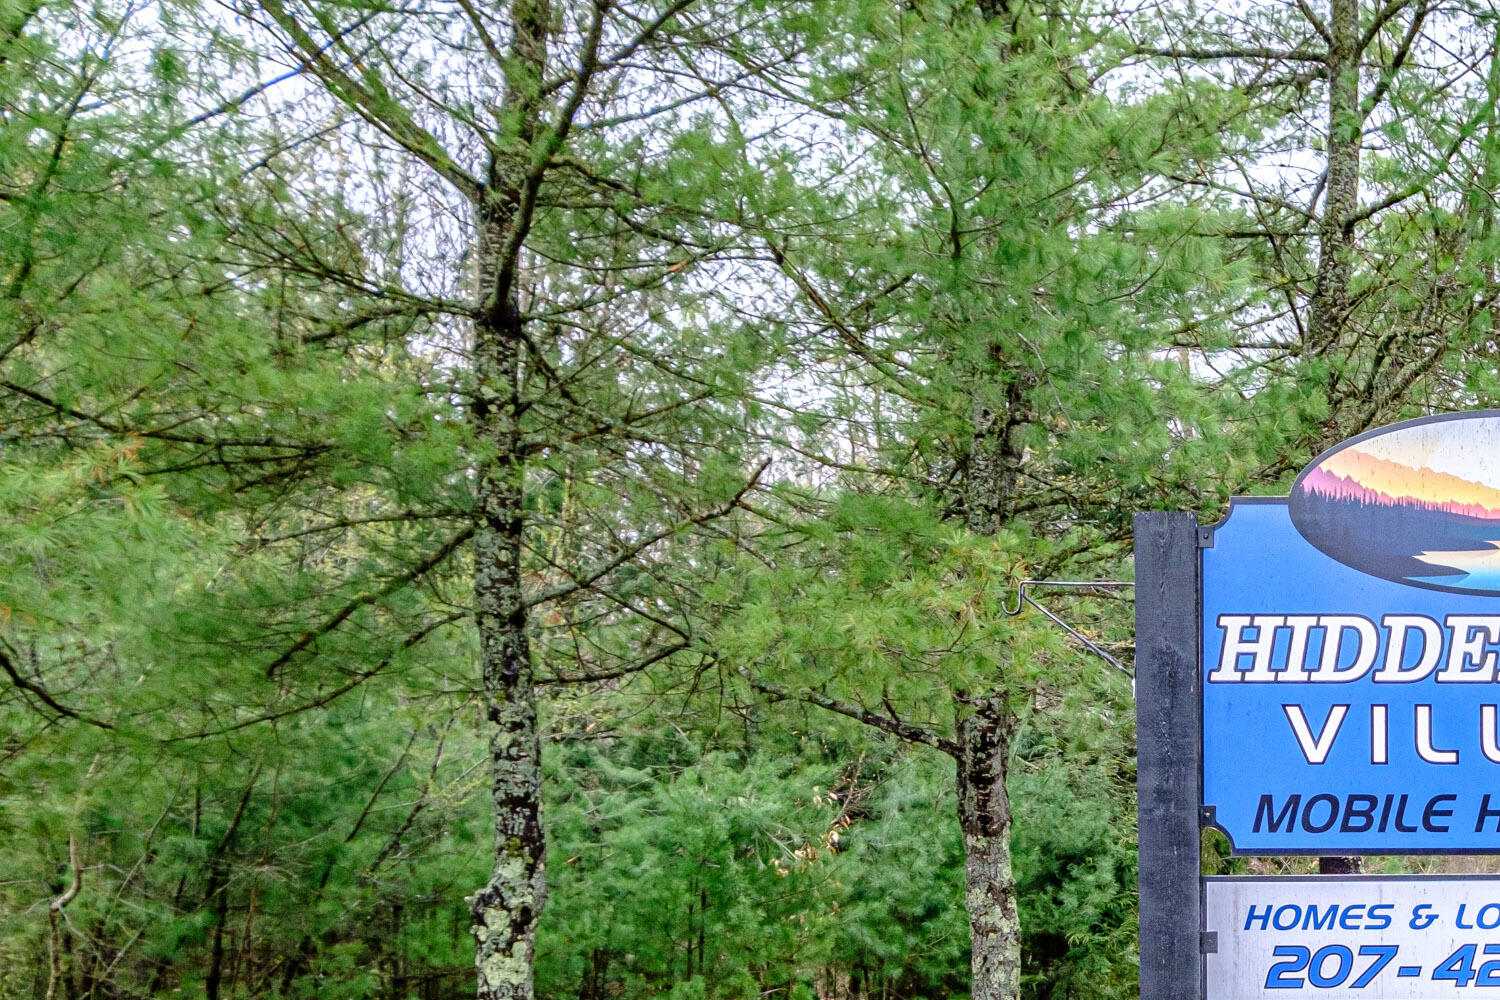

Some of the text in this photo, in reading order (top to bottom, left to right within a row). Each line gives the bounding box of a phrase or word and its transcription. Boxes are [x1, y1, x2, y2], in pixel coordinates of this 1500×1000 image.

[1252, 793, 1455, 834] MOBILE
[1243, 904, 1395, 931] HOMES
[1408, 904, 1439, 931] &
